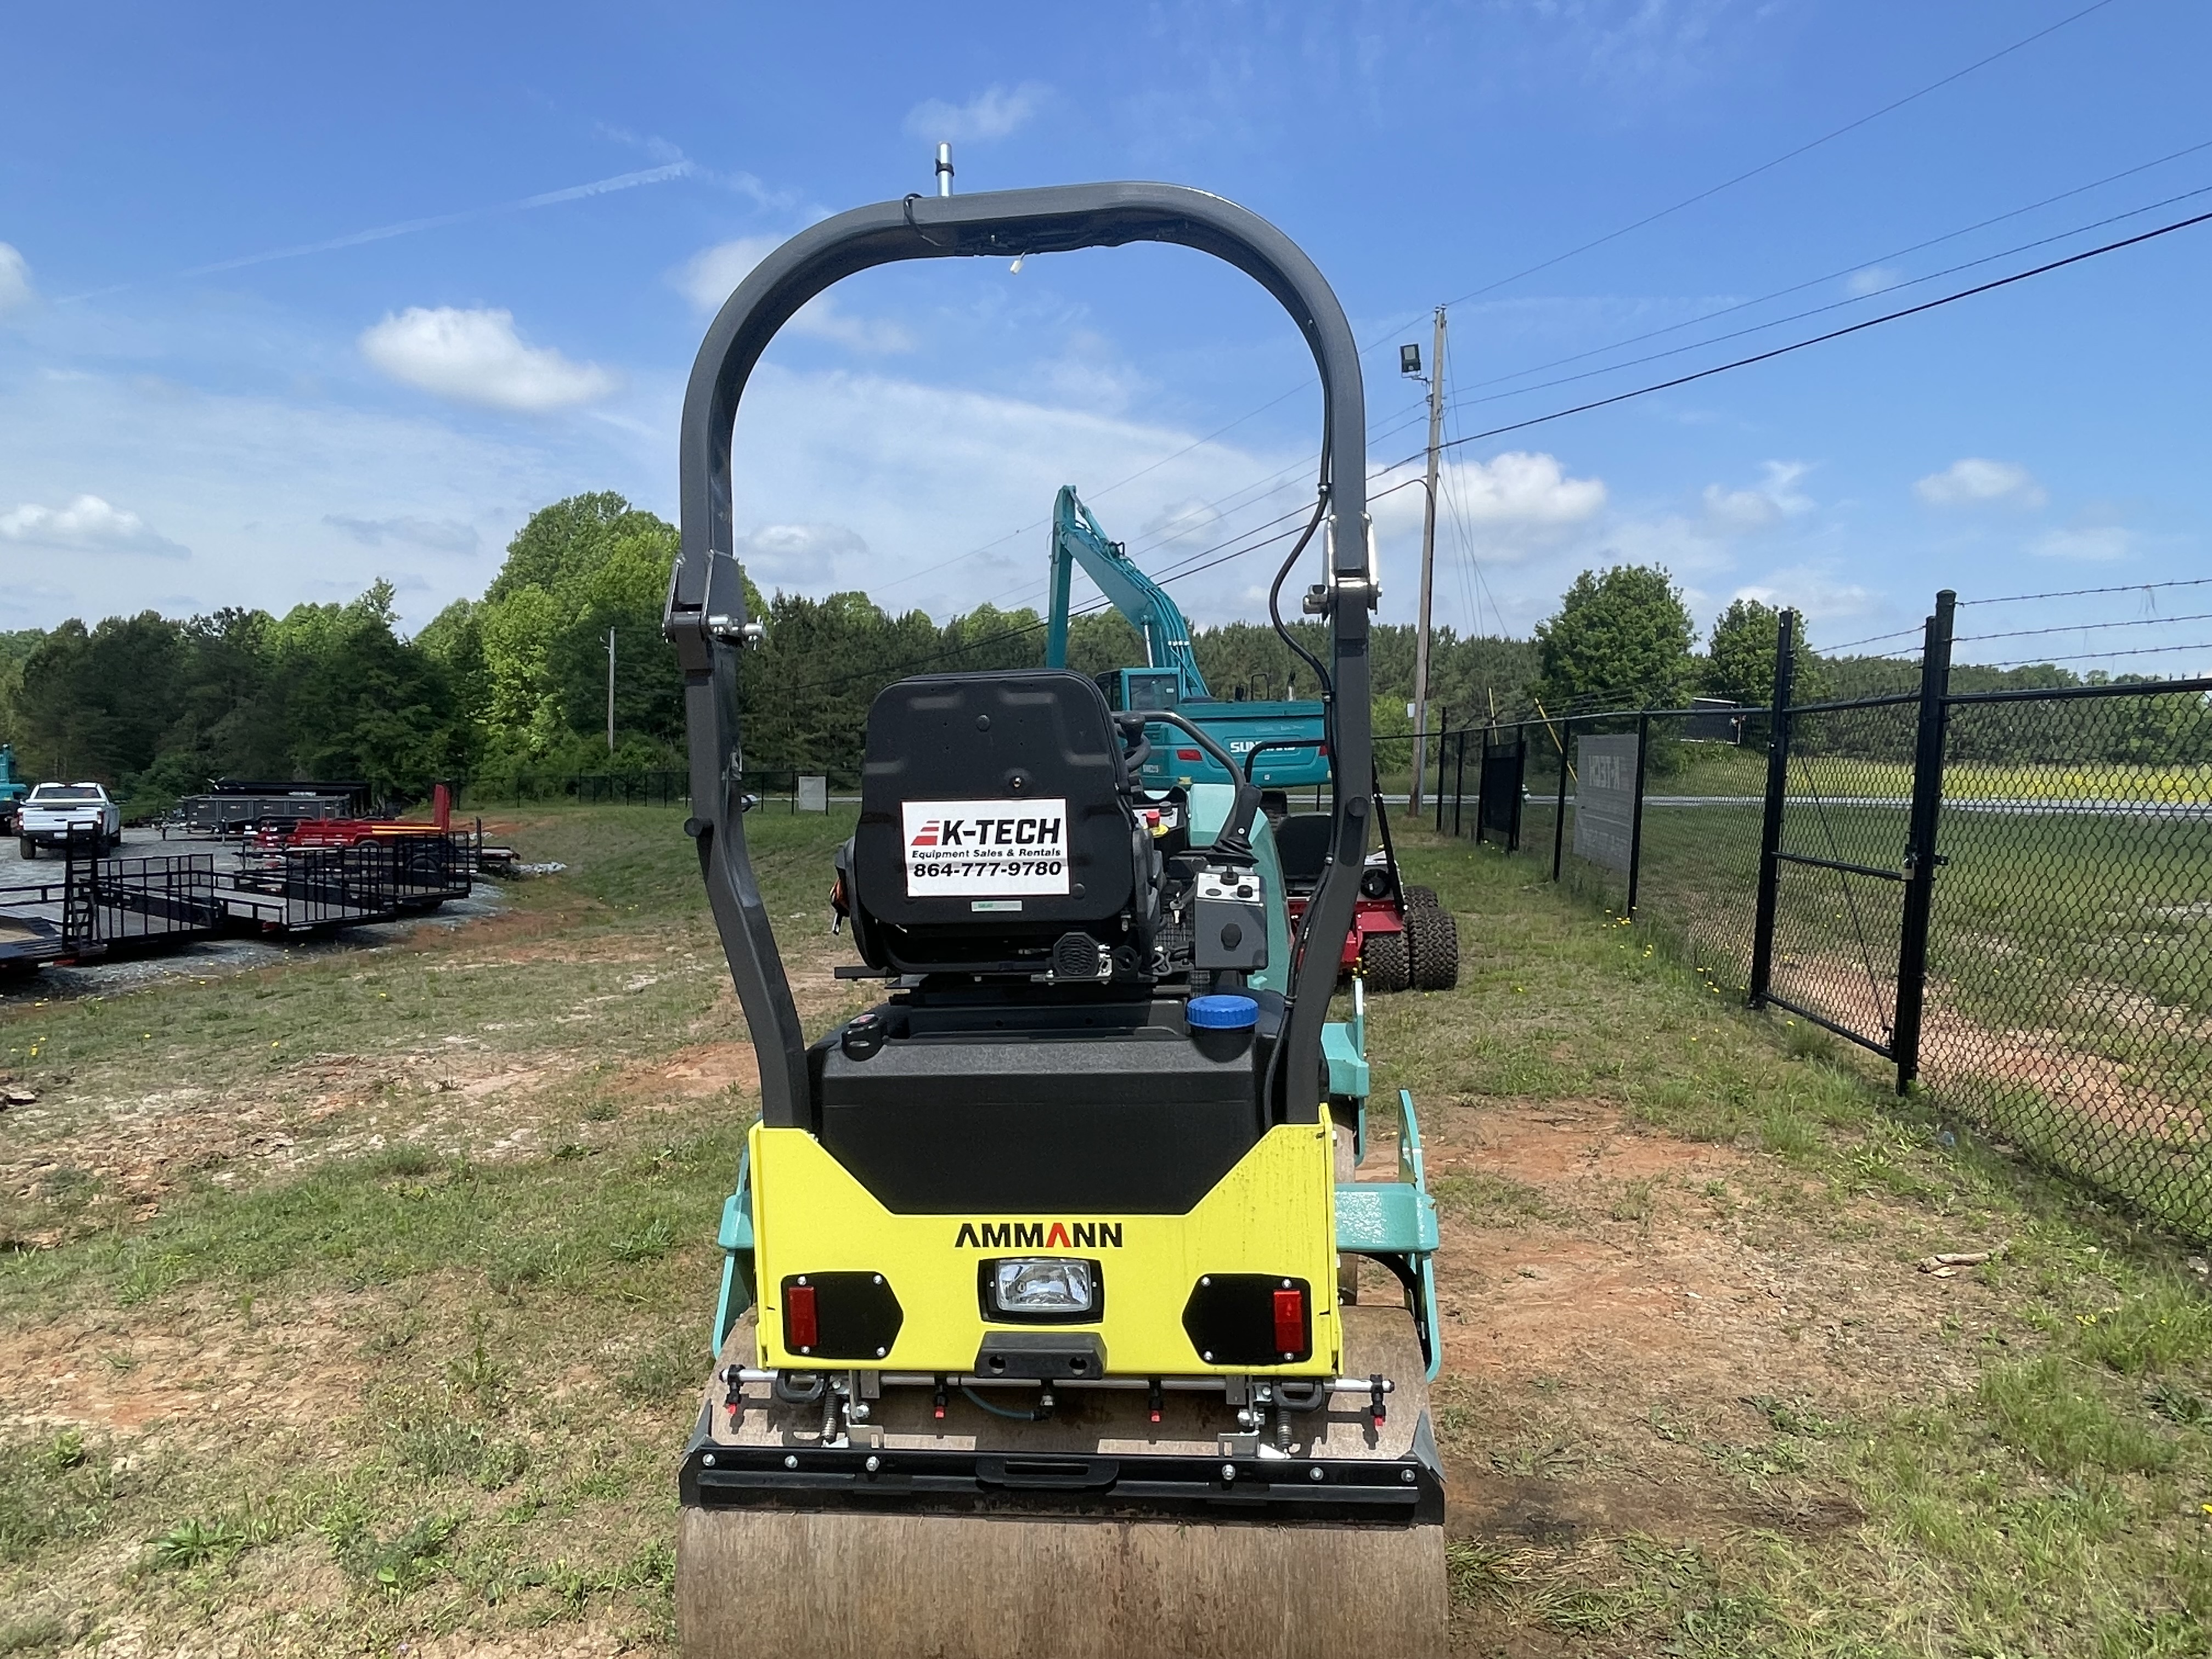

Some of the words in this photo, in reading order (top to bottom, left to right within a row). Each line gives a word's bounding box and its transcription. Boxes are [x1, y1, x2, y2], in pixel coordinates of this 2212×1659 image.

[941, 817, 1061, 846] K-TECH
[911, 850, 970, 860] Equipment
[973, 849, 1003, 857] Sales
[1006, 849, 1014, 857] &
[1018, 848, 1061, 856] Rentals
[913, 861, 1062, 877] 864-777-9780
[955, 1222, 1123, 1248] AMMANN
